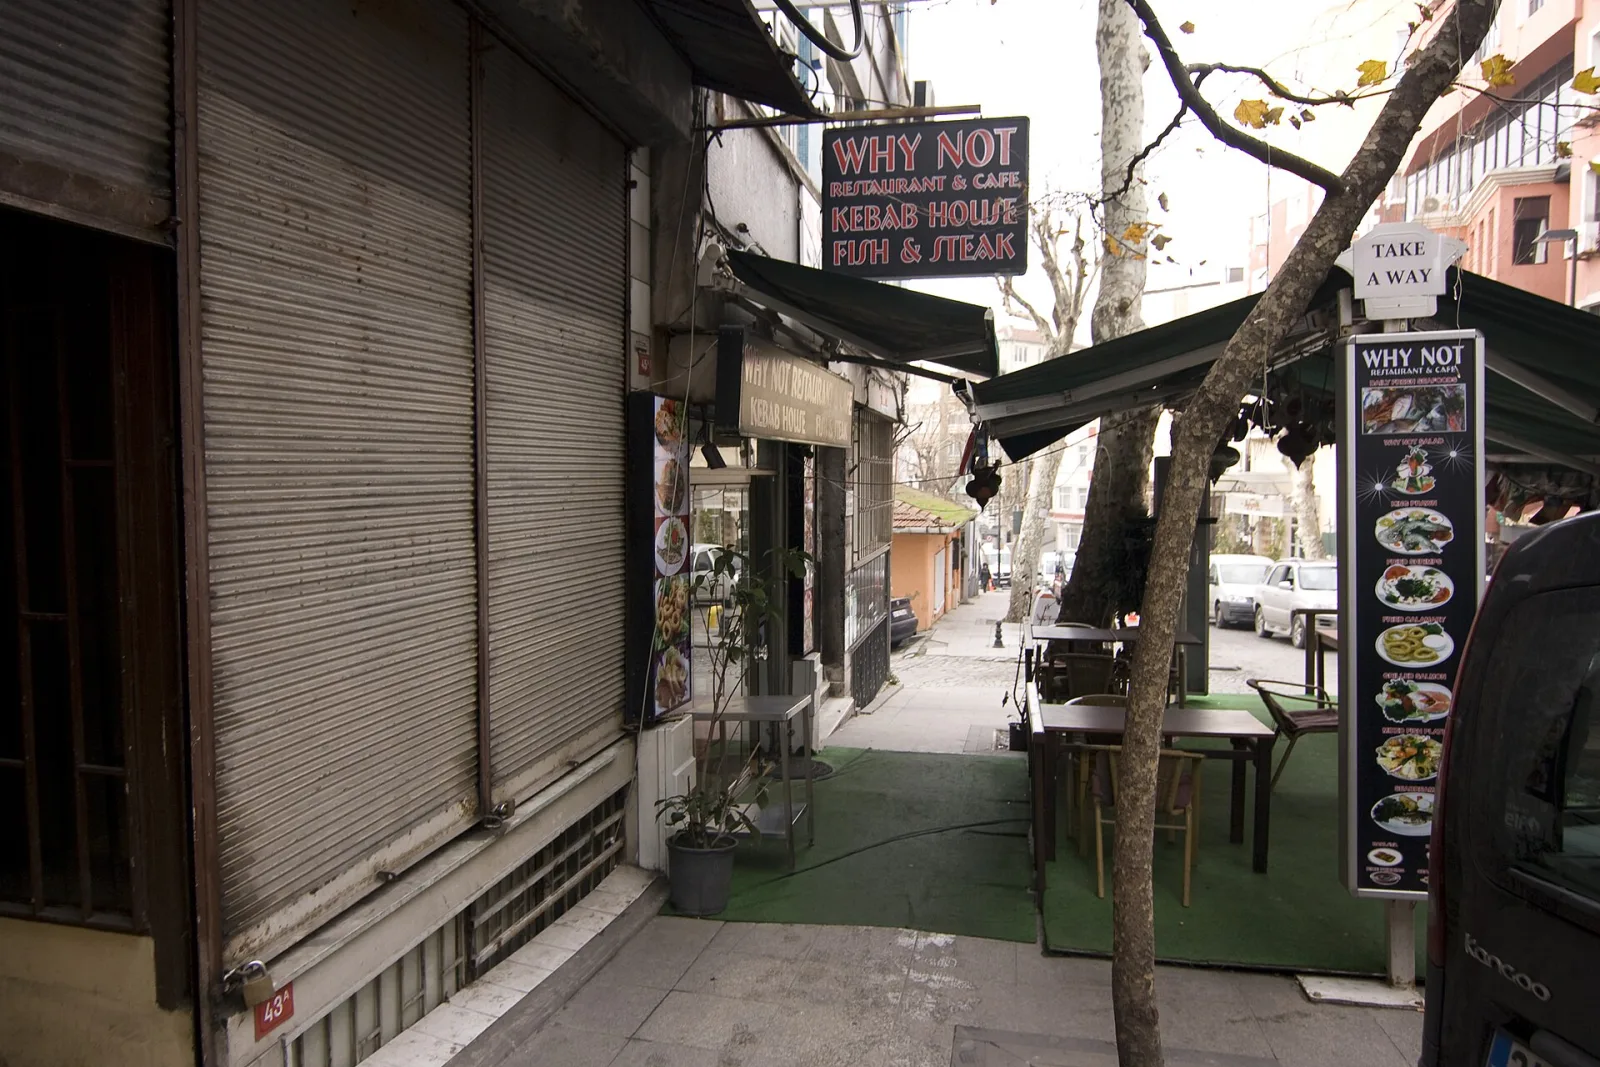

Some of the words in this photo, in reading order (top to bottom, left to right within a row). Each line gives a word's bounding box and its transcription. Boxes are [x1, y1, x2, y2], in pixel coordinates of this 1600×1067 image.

[832, 132, 922, 174] WHY
[937, 127, 1018, 170] NOT
[830, 175, 946, 197] RESTAURANT
[952, 174, 967, 191] &
[972, 171, 1020, 190] CAFE
[831, 202, 918, 232] KEBAB
[928, 197, 1019, 228] HOUSE
[833, 238, 889, 266] FISH
[900, 237, 922, 264] &
[929, 232, 1016, 262] STEAK
[1371, 241, 1425, 258] TAKE
[1367, 273, 1380, 286] A
[1385, 268, 1433, 285] WAY
[1362, 347, 1413, 369] WHY
[1421, 345, 1465, 366] NOT
[744, 346, 770, 388] WHY
[771, 357, 791, 395] NOT
[1371, 367, 1423, 376] RESTAURANT
[1435, 365, 1457, 374] CAFE
[750, 396, 780, 430] KEBAB
[782, 405, 806, 435] HOUSE
[1383, 439, 1402, 447] WHY
